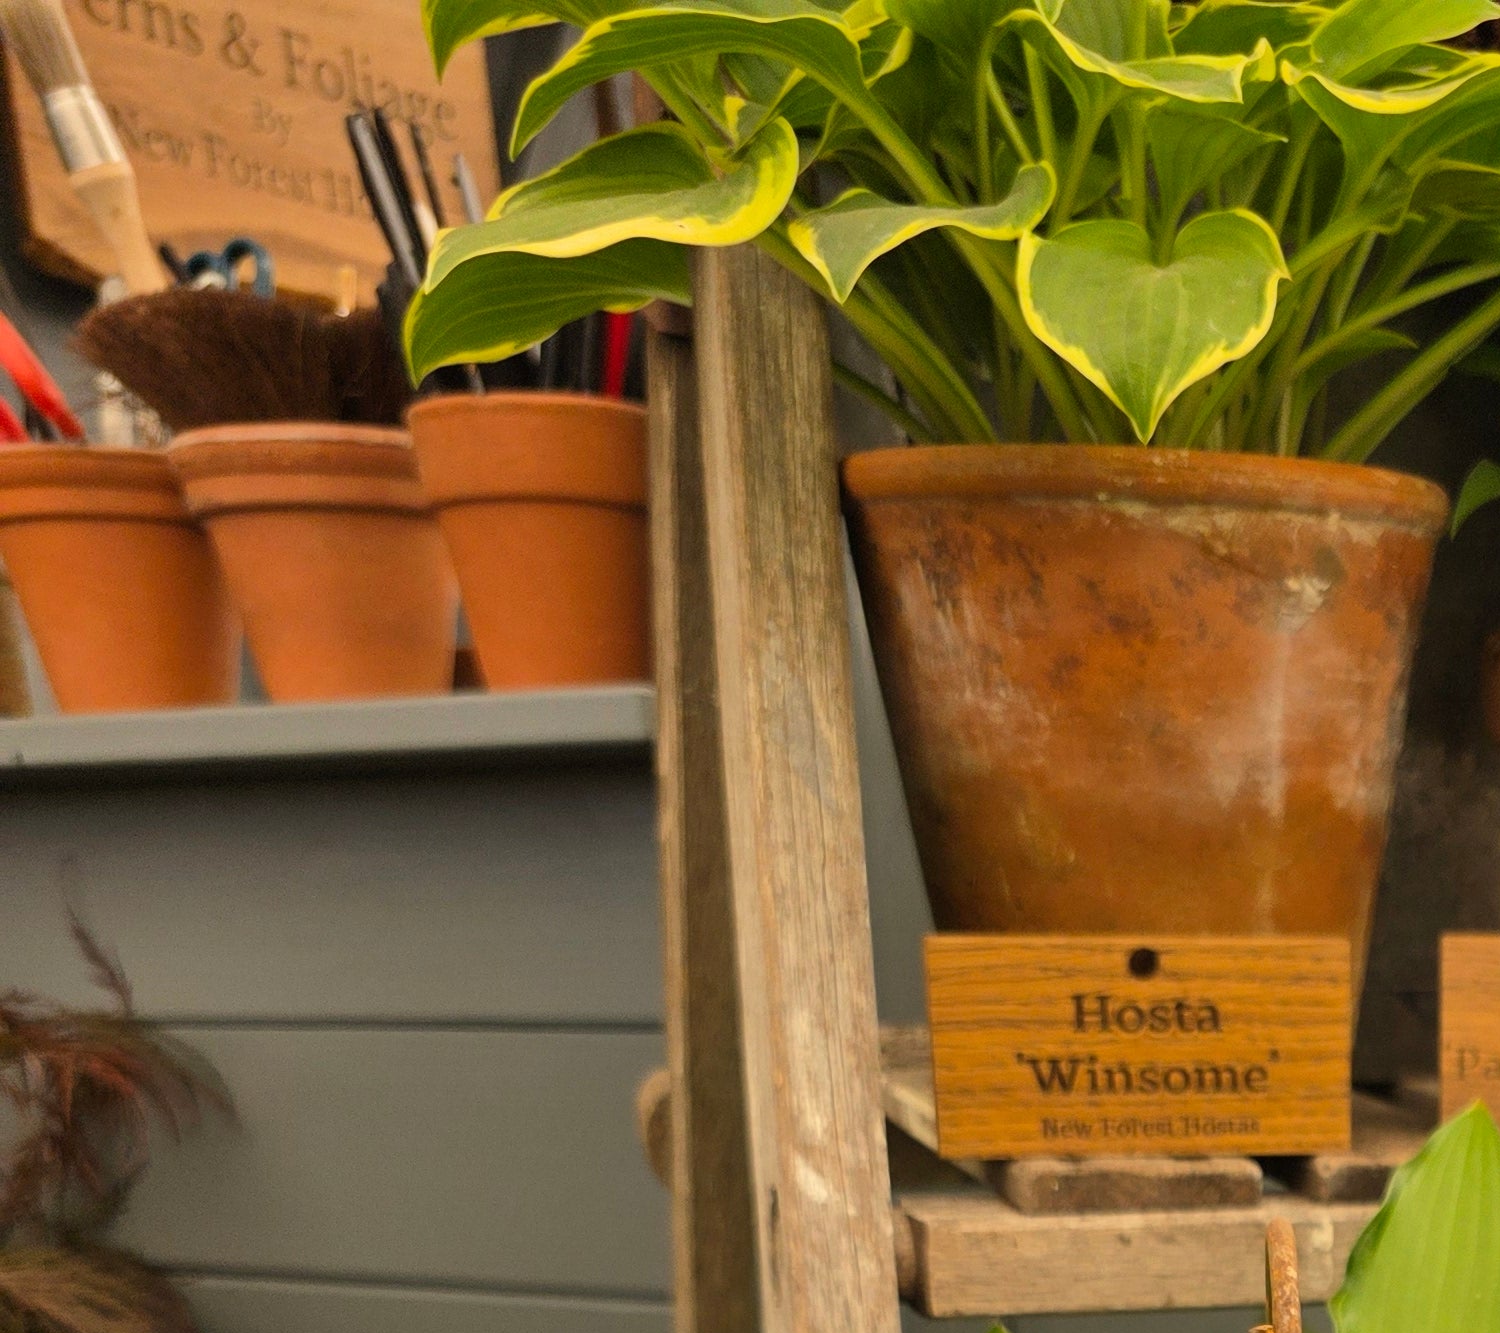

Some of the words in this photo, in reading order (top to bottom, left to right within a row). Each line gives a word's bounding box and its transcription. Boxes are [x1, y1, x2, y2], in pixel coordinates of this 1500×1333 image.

[81, 0, 206, 57] erns
[217, 11, 267, 78] &
[279, 26, 460, 148] Foliage
[253, 99, 295, 147] By
[1070, 993, 1224, 1035] Hosta
[1015, 1048, 1280, 1097] 'Winsome'
[1041, 1117, 1093, 1139] New
[1103, 1116, 1175, 1138] Forest
[1182, 1114, 1261, 1136] Hostas
